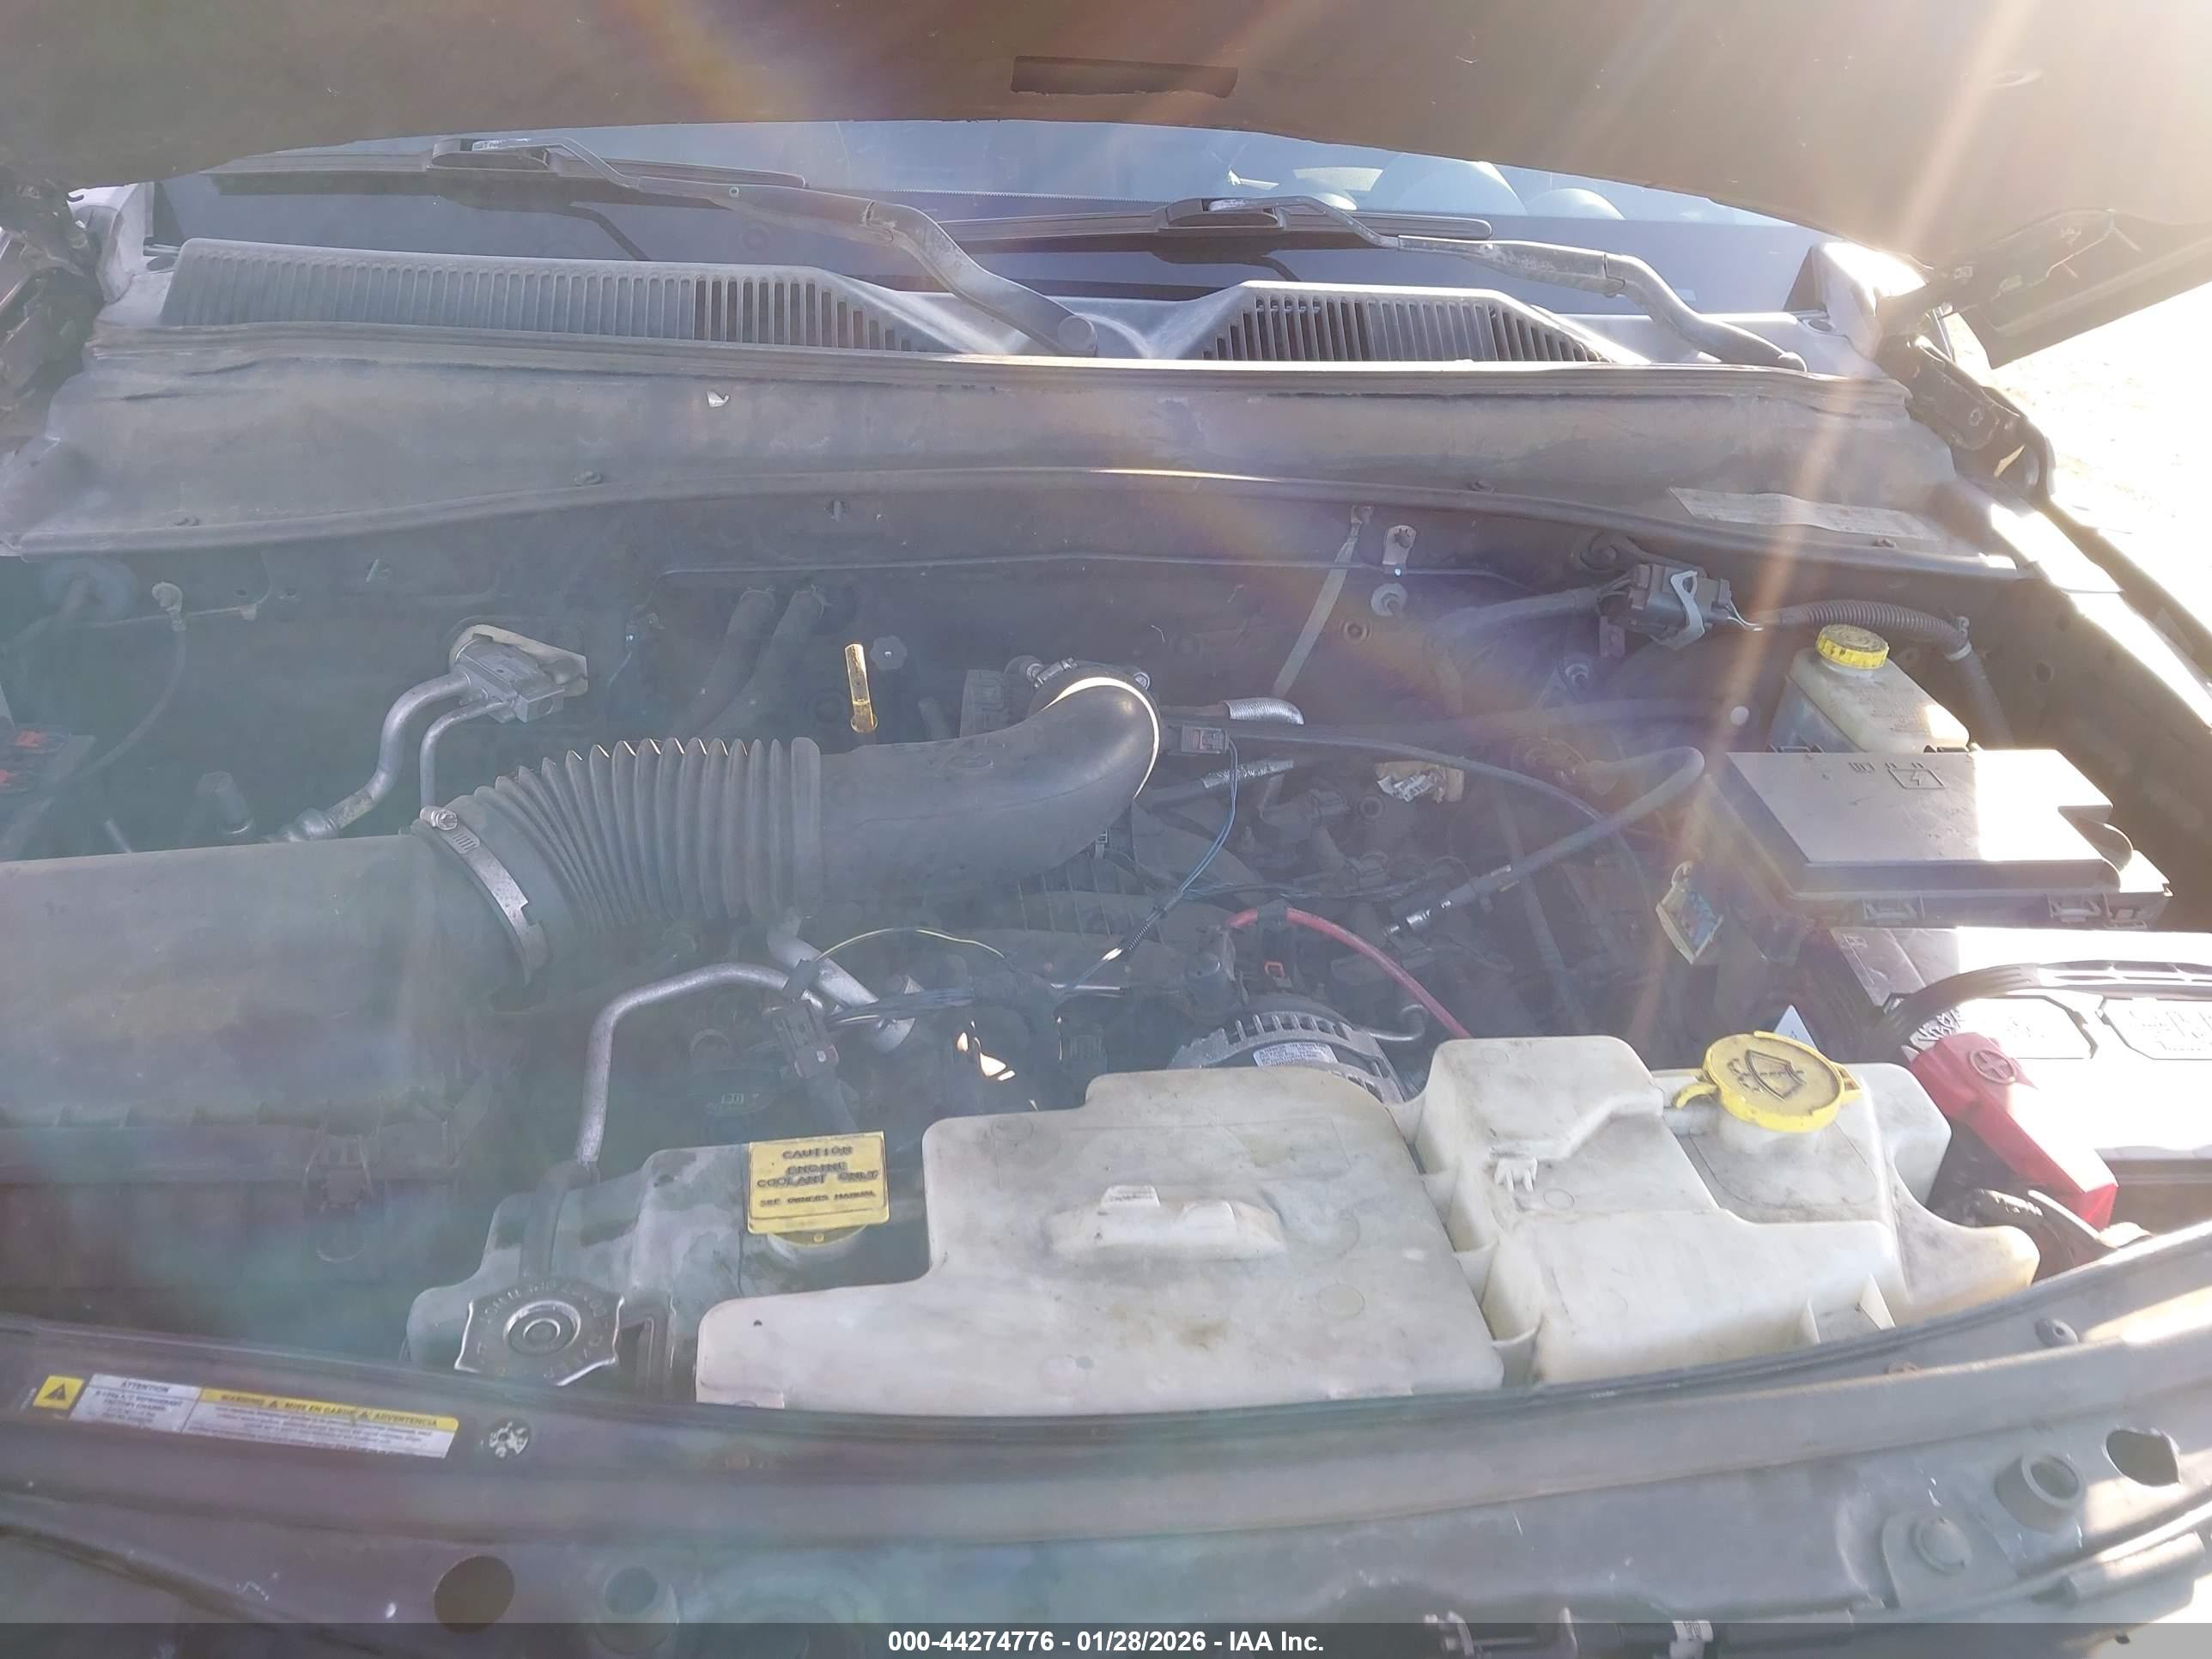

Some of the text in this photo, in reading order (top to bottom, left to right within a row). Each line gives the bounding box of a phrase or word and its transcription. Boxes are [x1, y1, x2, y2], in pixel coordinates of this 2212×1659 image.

[782, 1145, 853, 1159] CAUTION
[786, 1161, 848, 1176] ENGINE
[757, 1169, 879, 1188] COOLANT ONLY
[120, 1381, 171, 1393] ATTENTION
[284, 1402, 307, 1412] MISE
[308, 1404, 322, 1413] EN
[372, 1412, 437, 1425] ADVERTENCIA
